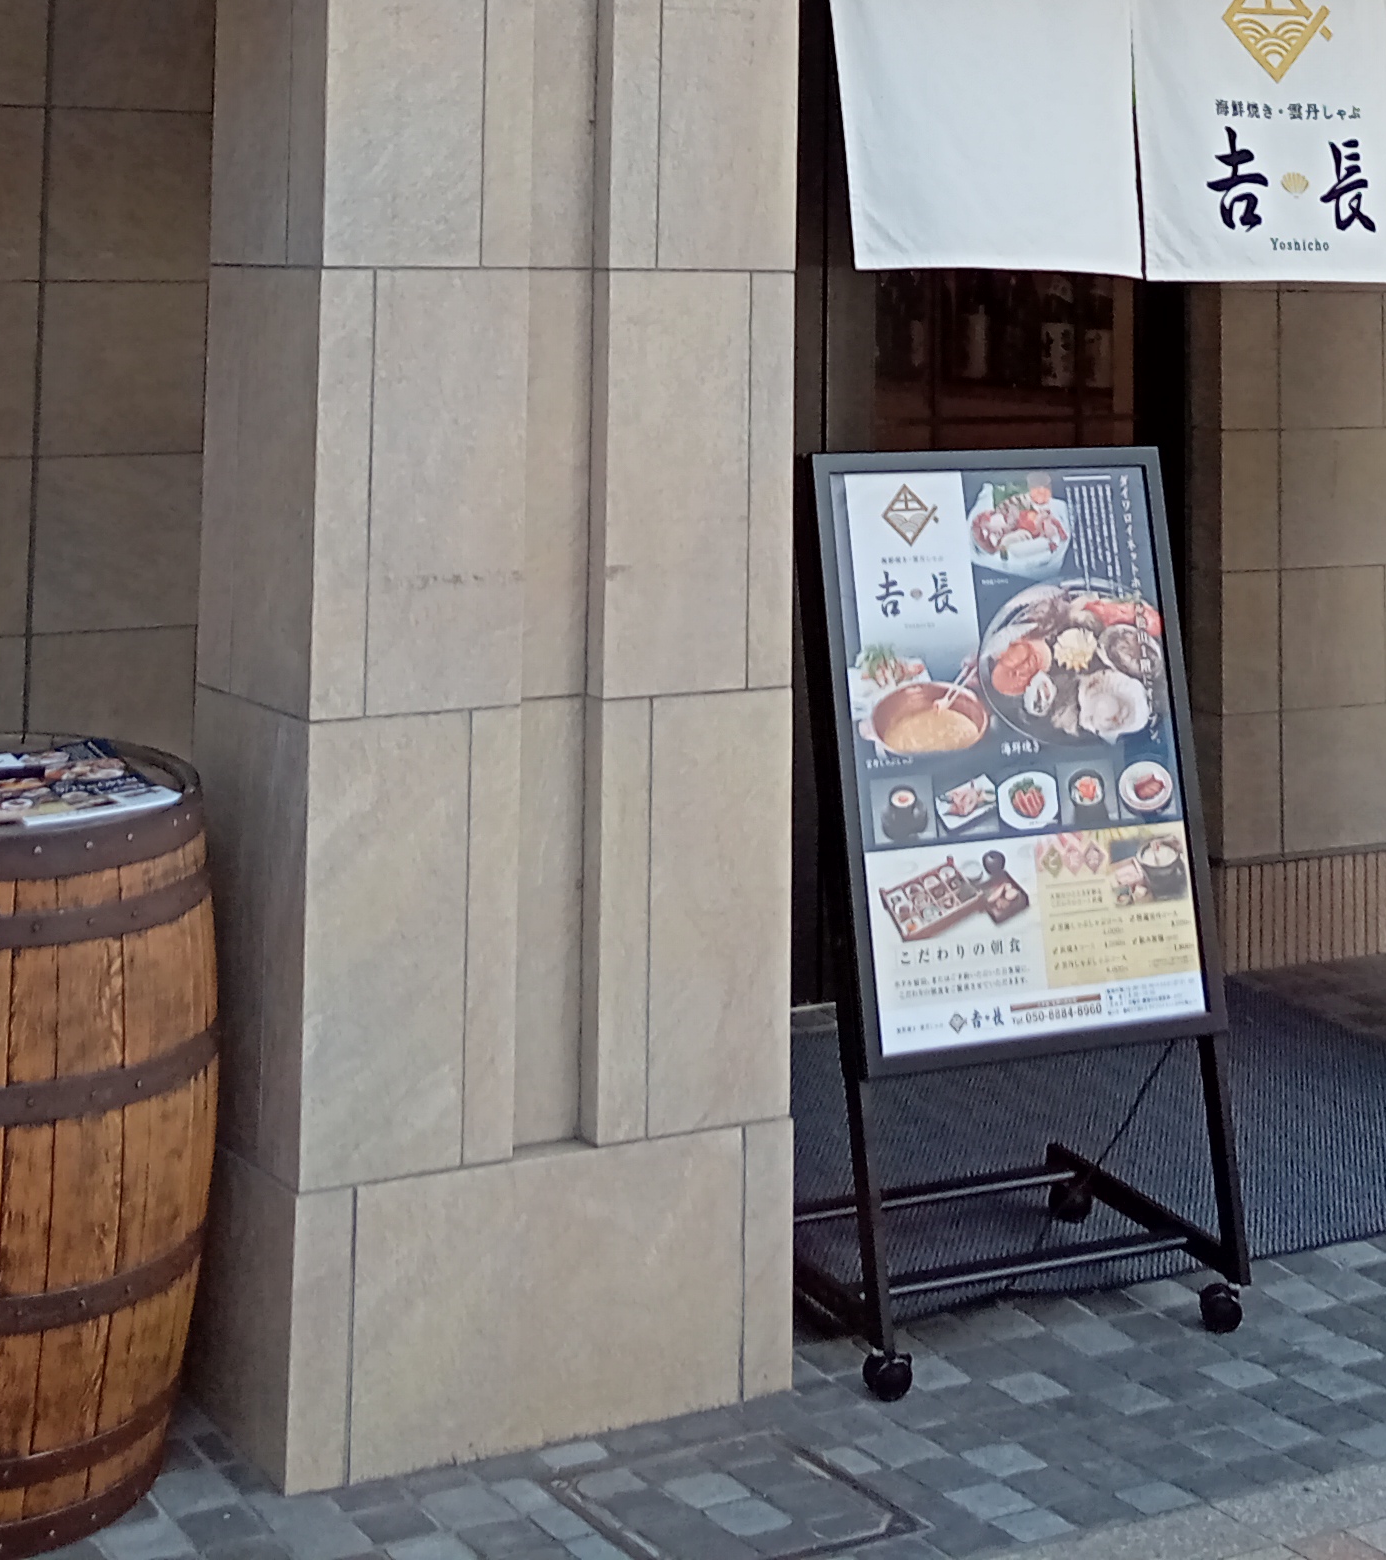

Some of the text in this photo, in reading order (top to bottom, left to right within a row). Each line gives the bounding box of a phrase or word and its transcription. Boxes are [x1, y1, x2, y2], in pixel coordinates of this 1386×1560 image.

[1214, 98, 1361, 121] 海鮮焼き・雲丹しゃぶ
[1270, 237, 1330, 252] Yoshicho
[900, 937, 1021, 965] こだわりの朝食
